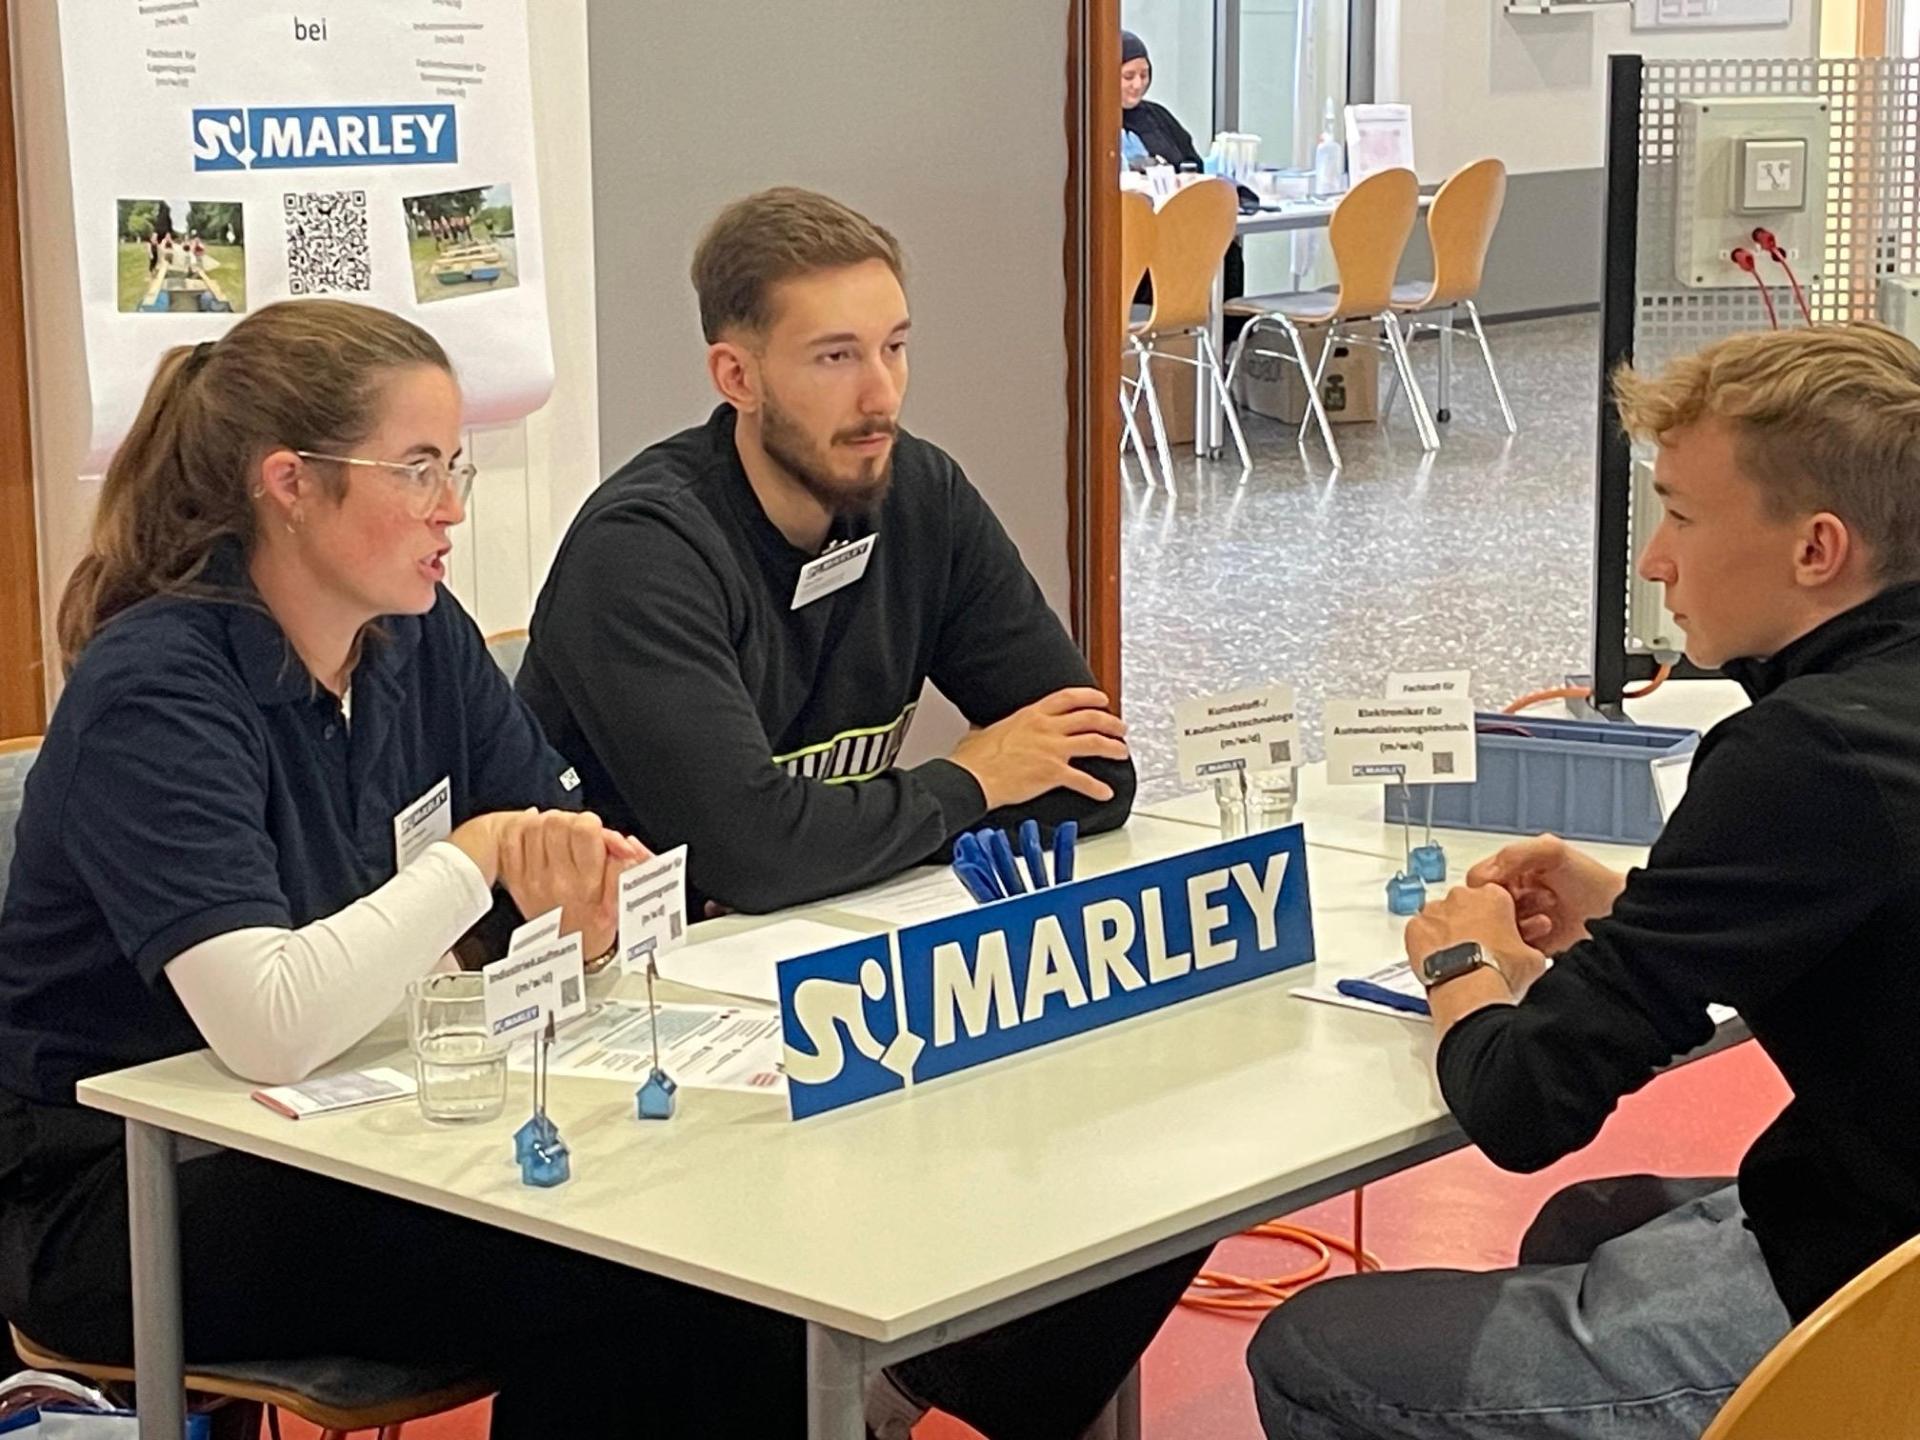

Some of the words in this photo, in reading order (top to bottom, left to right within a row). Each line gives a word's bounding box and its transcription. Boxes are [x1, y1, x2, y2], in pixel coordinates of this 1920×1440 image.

[294, 16, 327, 41] bei
[261, 113, 446, 158] MARLEY
[1358, 708, 1424, 718] Elektroniker
[1427, 706, 1442, 716] für
[934, 851, 1289, 1047] MARLEY
